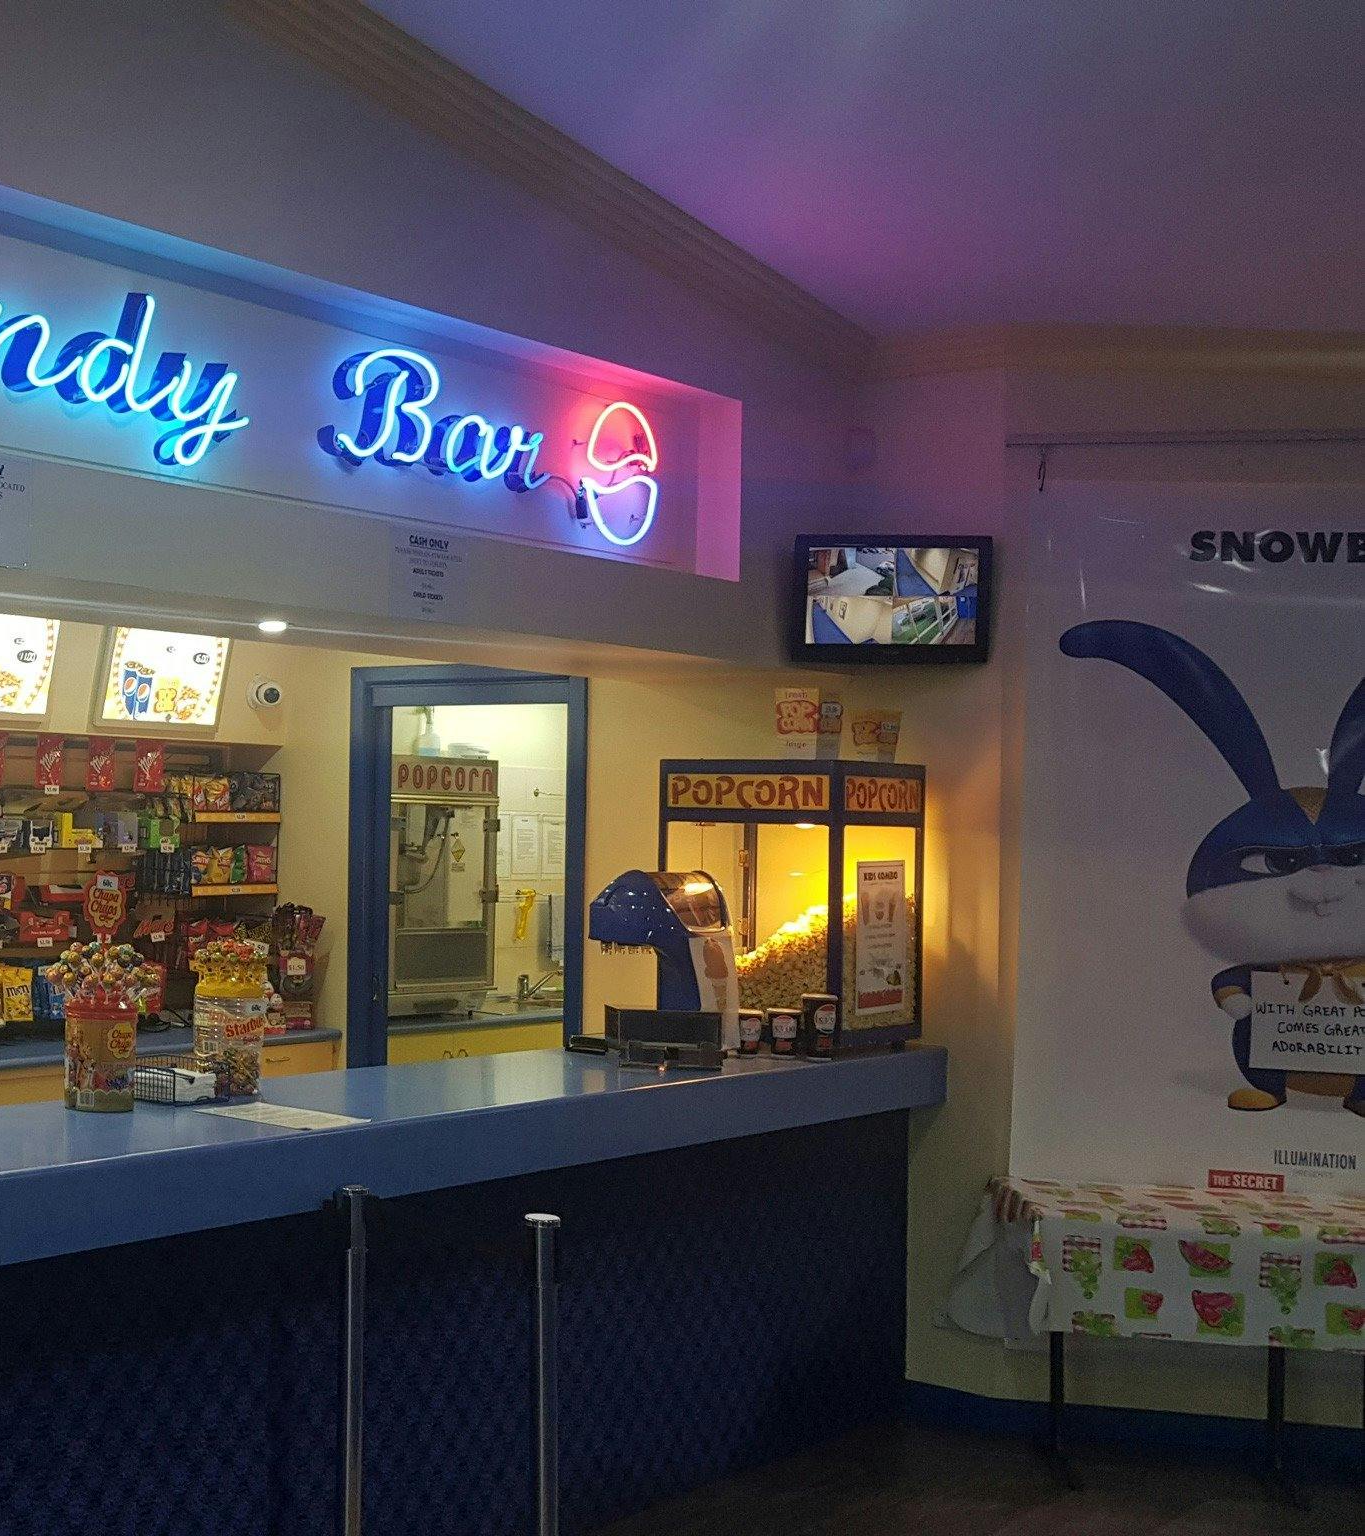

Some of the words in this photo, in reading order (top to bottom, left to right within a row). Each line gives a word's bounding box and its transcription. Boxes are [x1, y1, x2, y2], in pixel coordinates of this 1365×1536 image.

[318, 349, 551, 494] Bar
[671, 775, 824, 811] POPCORN
[846, 778, 921, 813] POPCORN
[1255, 1001, 1295, 1015] WITH
[1302, 1004, 1347, 1018] GREAT
[1277, 1021, 1320, 1034] COMES
[1274, 1150, 1356, 1170] ILLUMINATION
[1213, 1175, 1231, 1187] THE
[1233, 1174, 1279, 1190] SECRET
